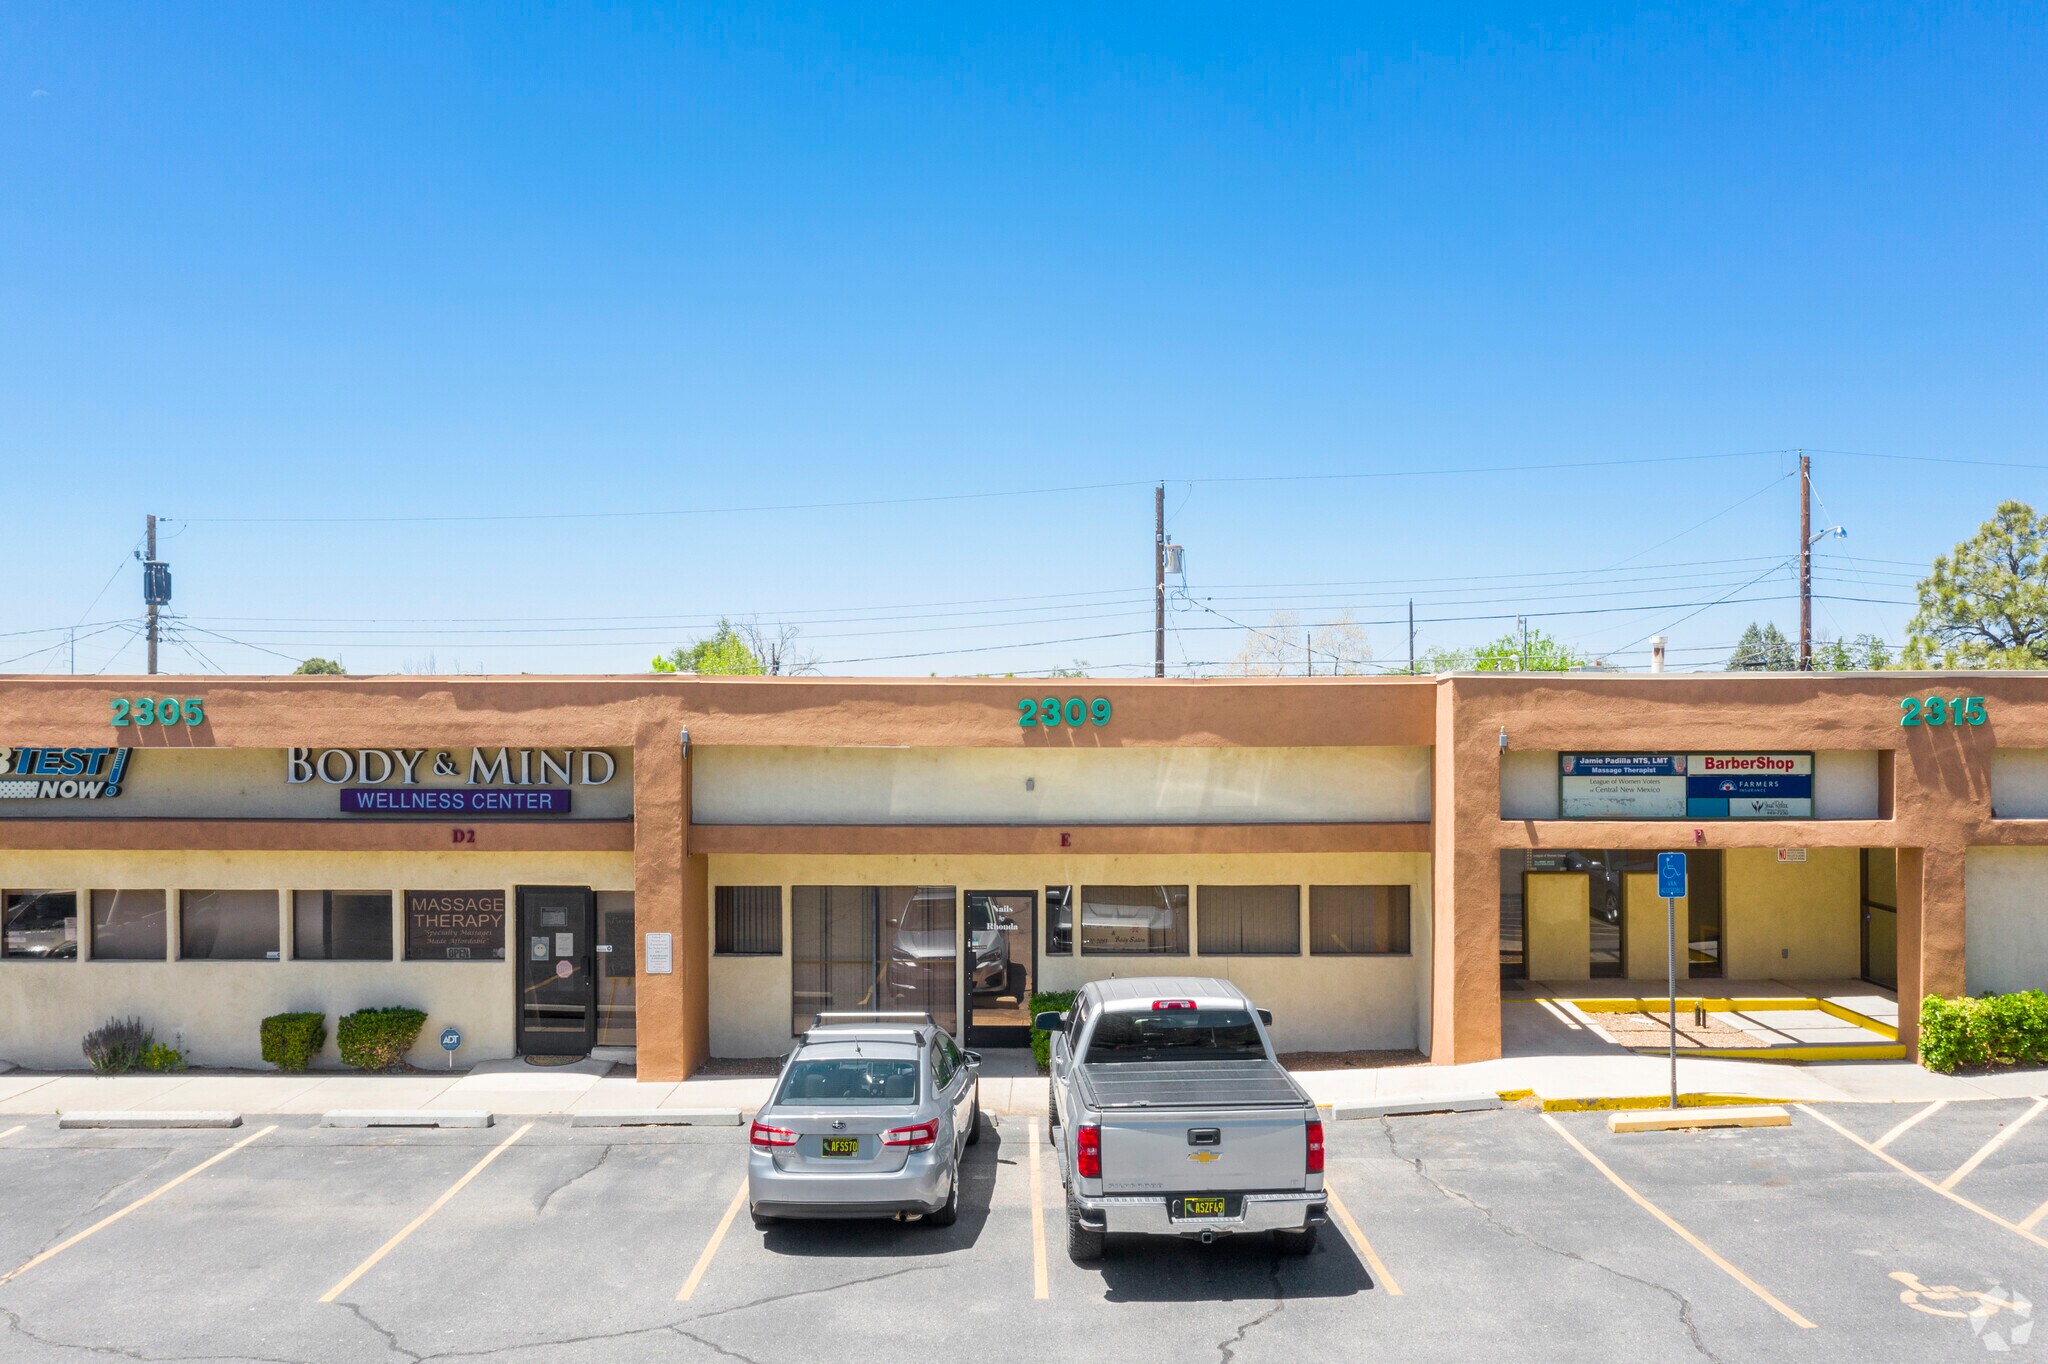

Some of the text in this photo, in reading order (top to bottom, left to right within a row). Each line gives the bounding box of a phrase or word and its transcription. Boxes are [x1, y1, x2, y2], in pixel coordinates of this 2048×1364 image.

[110, 697, 204, 726] 2305
[1018, 697, 1112, 727] 2309
[1900, 696, 1987, 726] 2315
[284, 747, 616, 785] BODY & MIND
[1633, 757, 1651, 765] NTS,
[1705, 756, 1794, 772] BarberShop
[1589, 778, 1609, 786] League
[39, 781, 105, 799] NOW
[357, 792, 552, 809] WELLNESS CENTER
[452, 829, 476, 843] D2
[1060, 833, 1071, 847] E
[412, 897, 504, 911] MASSAGE
[993, 905, 1013, 913] Nails
[414, 914, 503, 927] THERAPY
[986, 922, 1018, 930] Rhonda
[448, 948, 470, 958] OPEN
[443, 1035, 459, 1044] ADT
[831, 1141, 857, 1152] AFSS70
[1195, 1201, 1223, 1213] ASZF49
